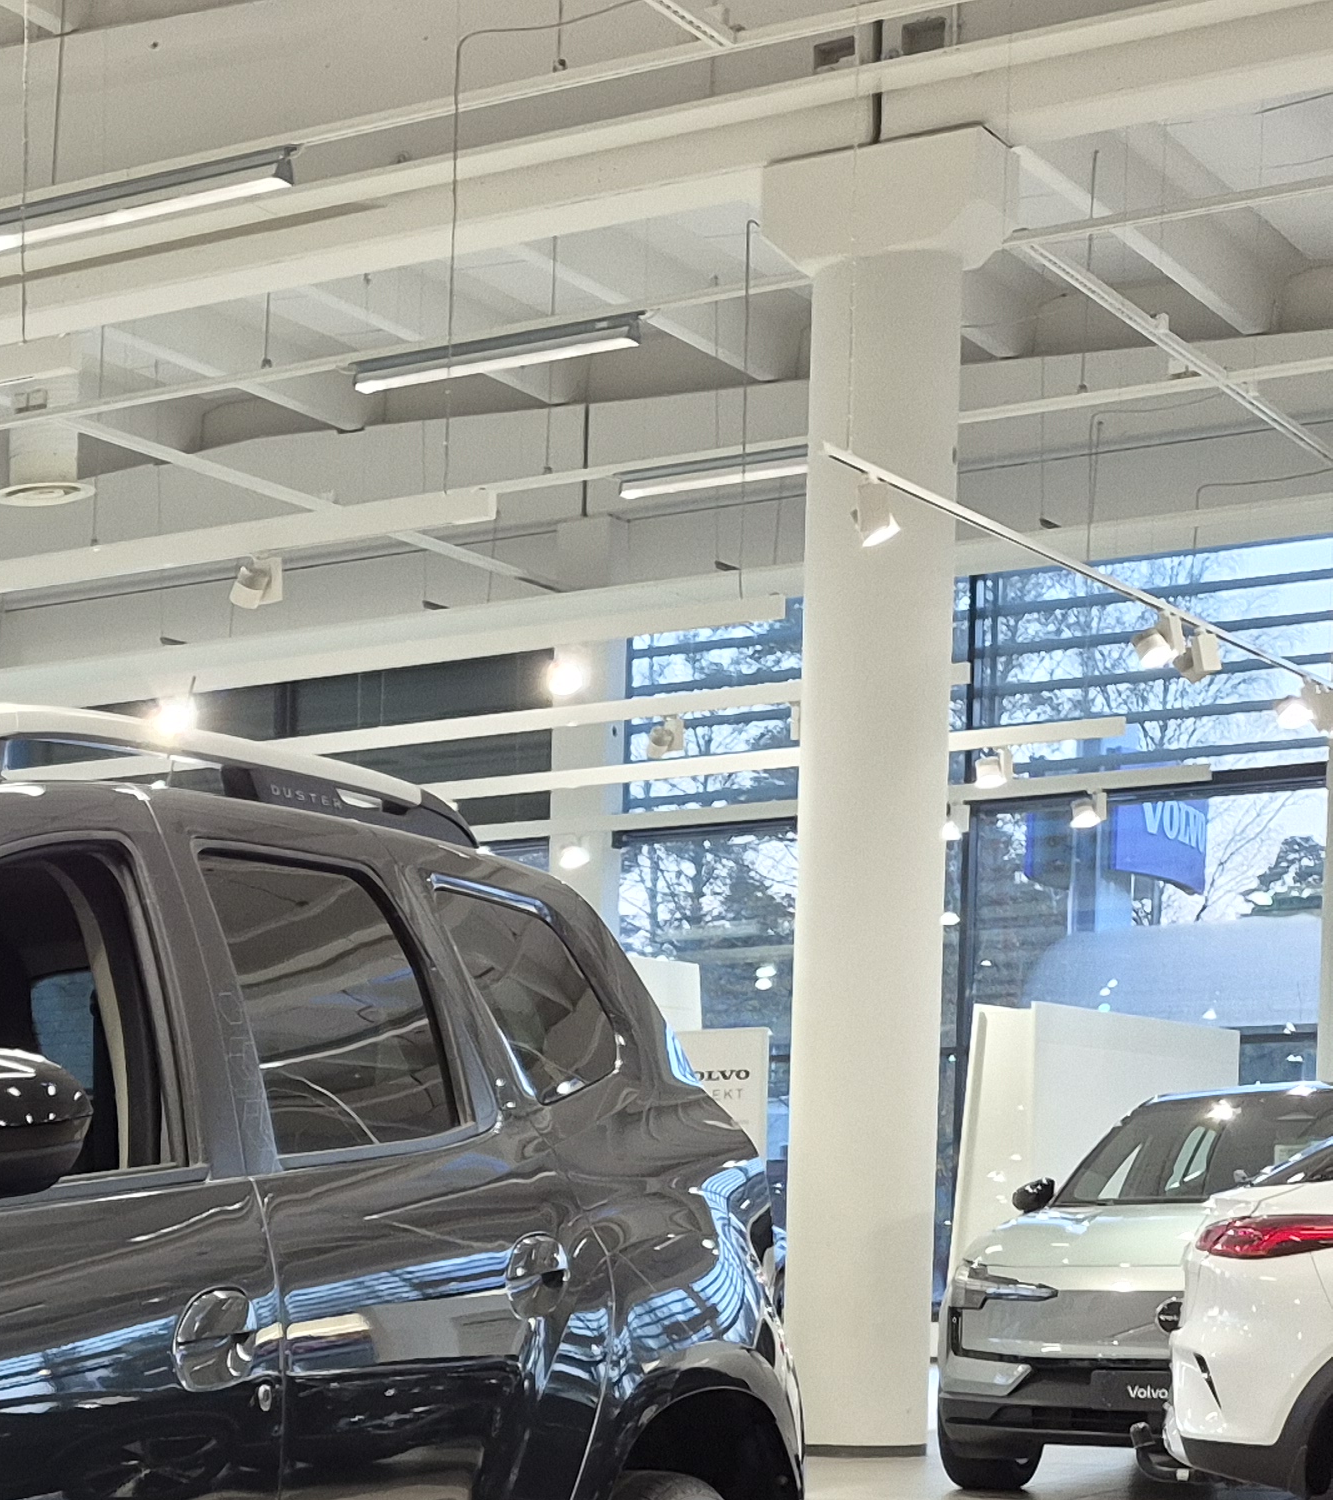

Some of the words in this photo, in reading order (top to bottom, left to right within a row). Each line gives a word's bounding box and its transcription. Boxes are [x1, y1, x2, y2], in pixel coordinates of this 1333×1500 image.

[270, 783, 343, 810] DUSTER
[1142, 801, 1206, 853] VOLVO
[693, 1069, 750, 1081] OLVO
[1127, 1385, 1169, 1399] Volvo
